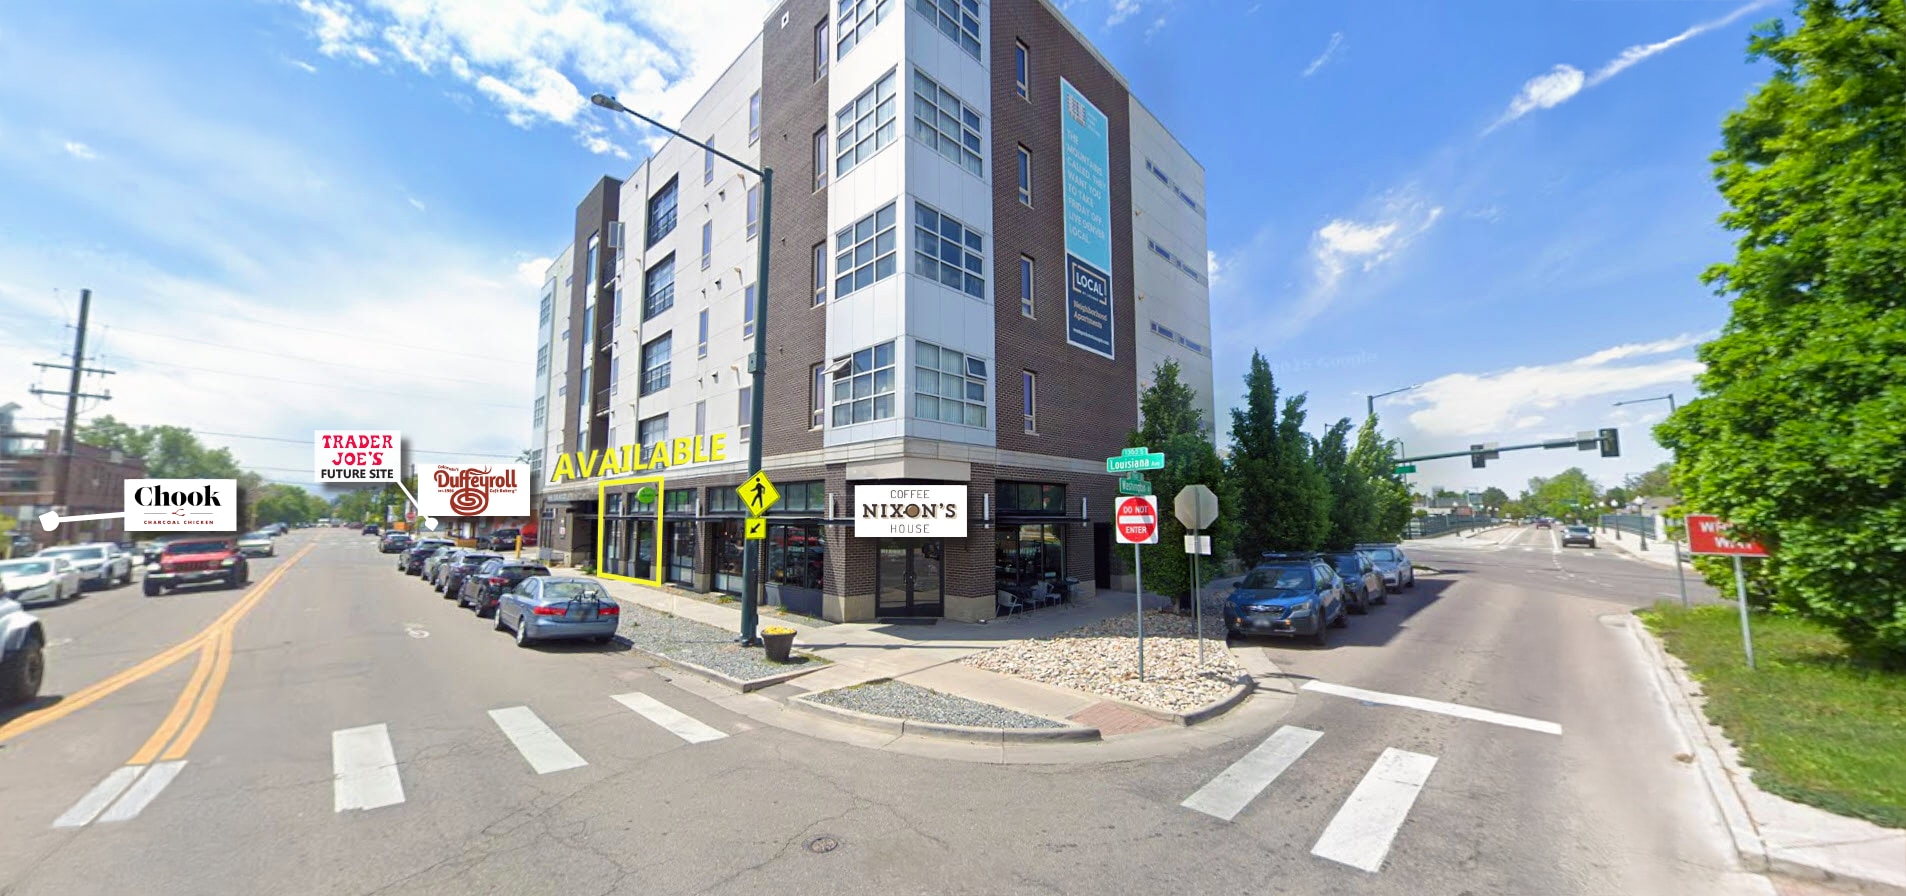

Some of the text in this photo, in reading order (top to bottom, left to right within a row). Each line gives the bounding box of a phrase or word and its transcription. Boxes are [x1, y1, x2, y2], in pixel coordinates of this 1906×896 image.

[1067, 129, 1079, 145] THE
[1067, 144, 1102, 176] MOUNTAINS
[1068, 170, 1102, 200] WANT YOU
[1068, 183, 1094, 208] TO TAKE
[1068, 198, 1090, 217] FRIDAY
[1069, 210, 1105, 240] LIVE DENVER
[1076, 271, 1103, 296] LOCAL
[1073, 300, 1108, 321] Neighborhood
[1073, 311, 1102, 330] Apartments
[1110, 458, 1149, 470] Louisiana
[1123, 505, 1149, 514] DO NOT
[1125, 526, 1147, 534] ENTER
